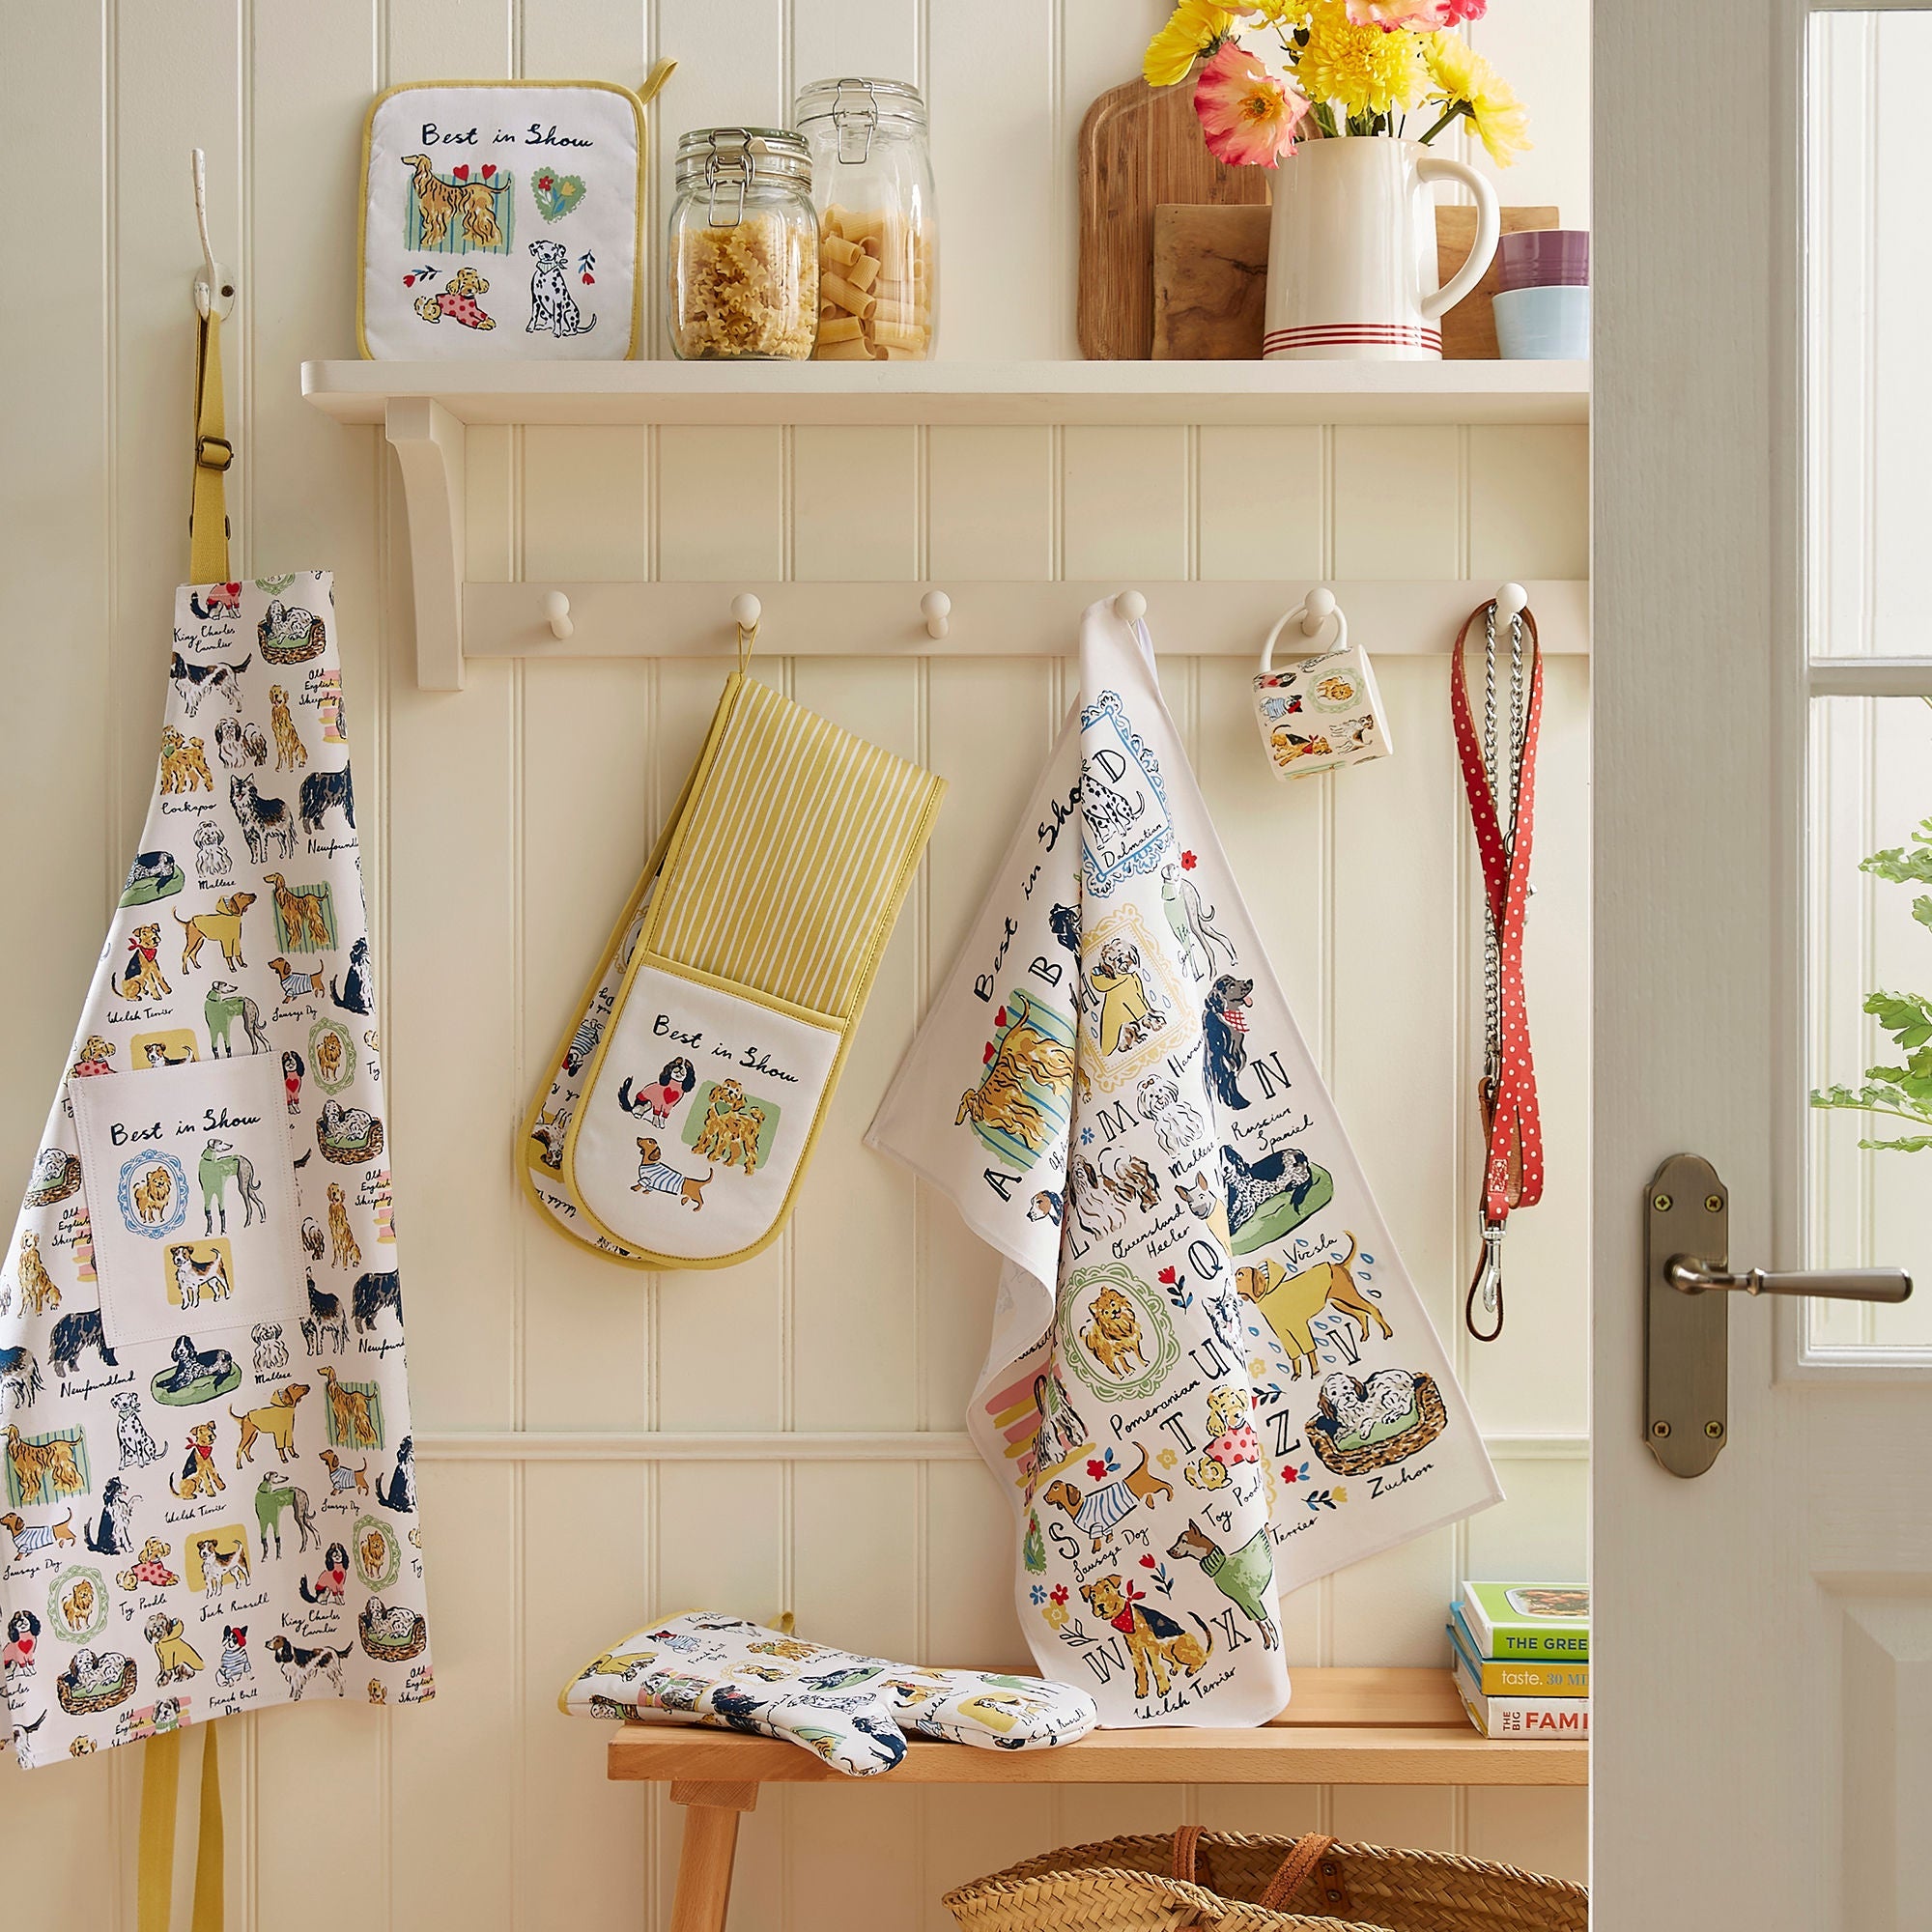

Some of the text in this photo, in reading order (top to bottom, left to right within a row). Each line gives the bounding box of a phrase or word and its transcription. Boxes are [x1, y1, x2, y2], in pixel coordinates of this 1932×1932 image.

[422, 123, 594, 148] Best in Show
[1092, 749, 1126, 784] D
[1101, 824, 1162, 868] Dalmatian
[973, 776, 1082, 1003] Best in Sho
[1028, 954, 1064, 987] B
[652, 1013, 801, 1084] Best in Show
[1249, 1051, 1293, 1099] N
[110, 1107, 262, 1147] Best in Show
[1095, 1099, 1140, 1143] M
[1231, 1108, 1292, 1141] Russian
[1257, 1115, 1314, 1153] Spaniel
[982, 1166, 1023, 1204] A
[62, 1207, 79, 1220] Old
[1111, 1203, 1186, 1260] Queensland
[1065, 1226, 1091, 1260] L
[1146, 1225, 1190, 1260] Heeler
[1187, 1239, 1224, 1281] Q
[1282, 1233, 1338, 1264] Vizsla
[1187, 1337, 1233, 1381] U
[1325, 1321, 1362, 1366] V
[1109, 1378, 1201, 1441] Pomeranian
[1158, 1410, 1197, 1456] T
[1265, 1408, 1301, 1458] Z
[1366, 1461, 1435, 1499] Zuchon
[1201, 1503, 1233, 1533] Toy
[1268, 1516, 1318, 1547] Terrier
[1047, 1521, 1080, 1561] S
[1072, 1526, 1151, 1583] Sausage Dog
[3, 1559, 63, 1581] Sausage Dog
[119, 1593, 168, 1621] Toy Poodle
[199, 1592, 270, 1623] Jack Russell
[280, 1608, 341, 1631] King Charles
[1210, 1606, 1253, 1653] X
[1506, 1637, 1588, 1650] THE GREE
[1082, 1636, 1127, 1685] W
[1501, 1670, 1544, 1686] taste.
[1547, 1673, 1563, 1686] 30
[1191, 1663, 1236, 1700] Terrier
[1133, 1690, 1191, 1720] Welsh
[1502, 1711, 1512, 1731] THE
[1512, 1711, 1521, 1731] BIG
[1526, 1712, 1588, 1729] FAMI
